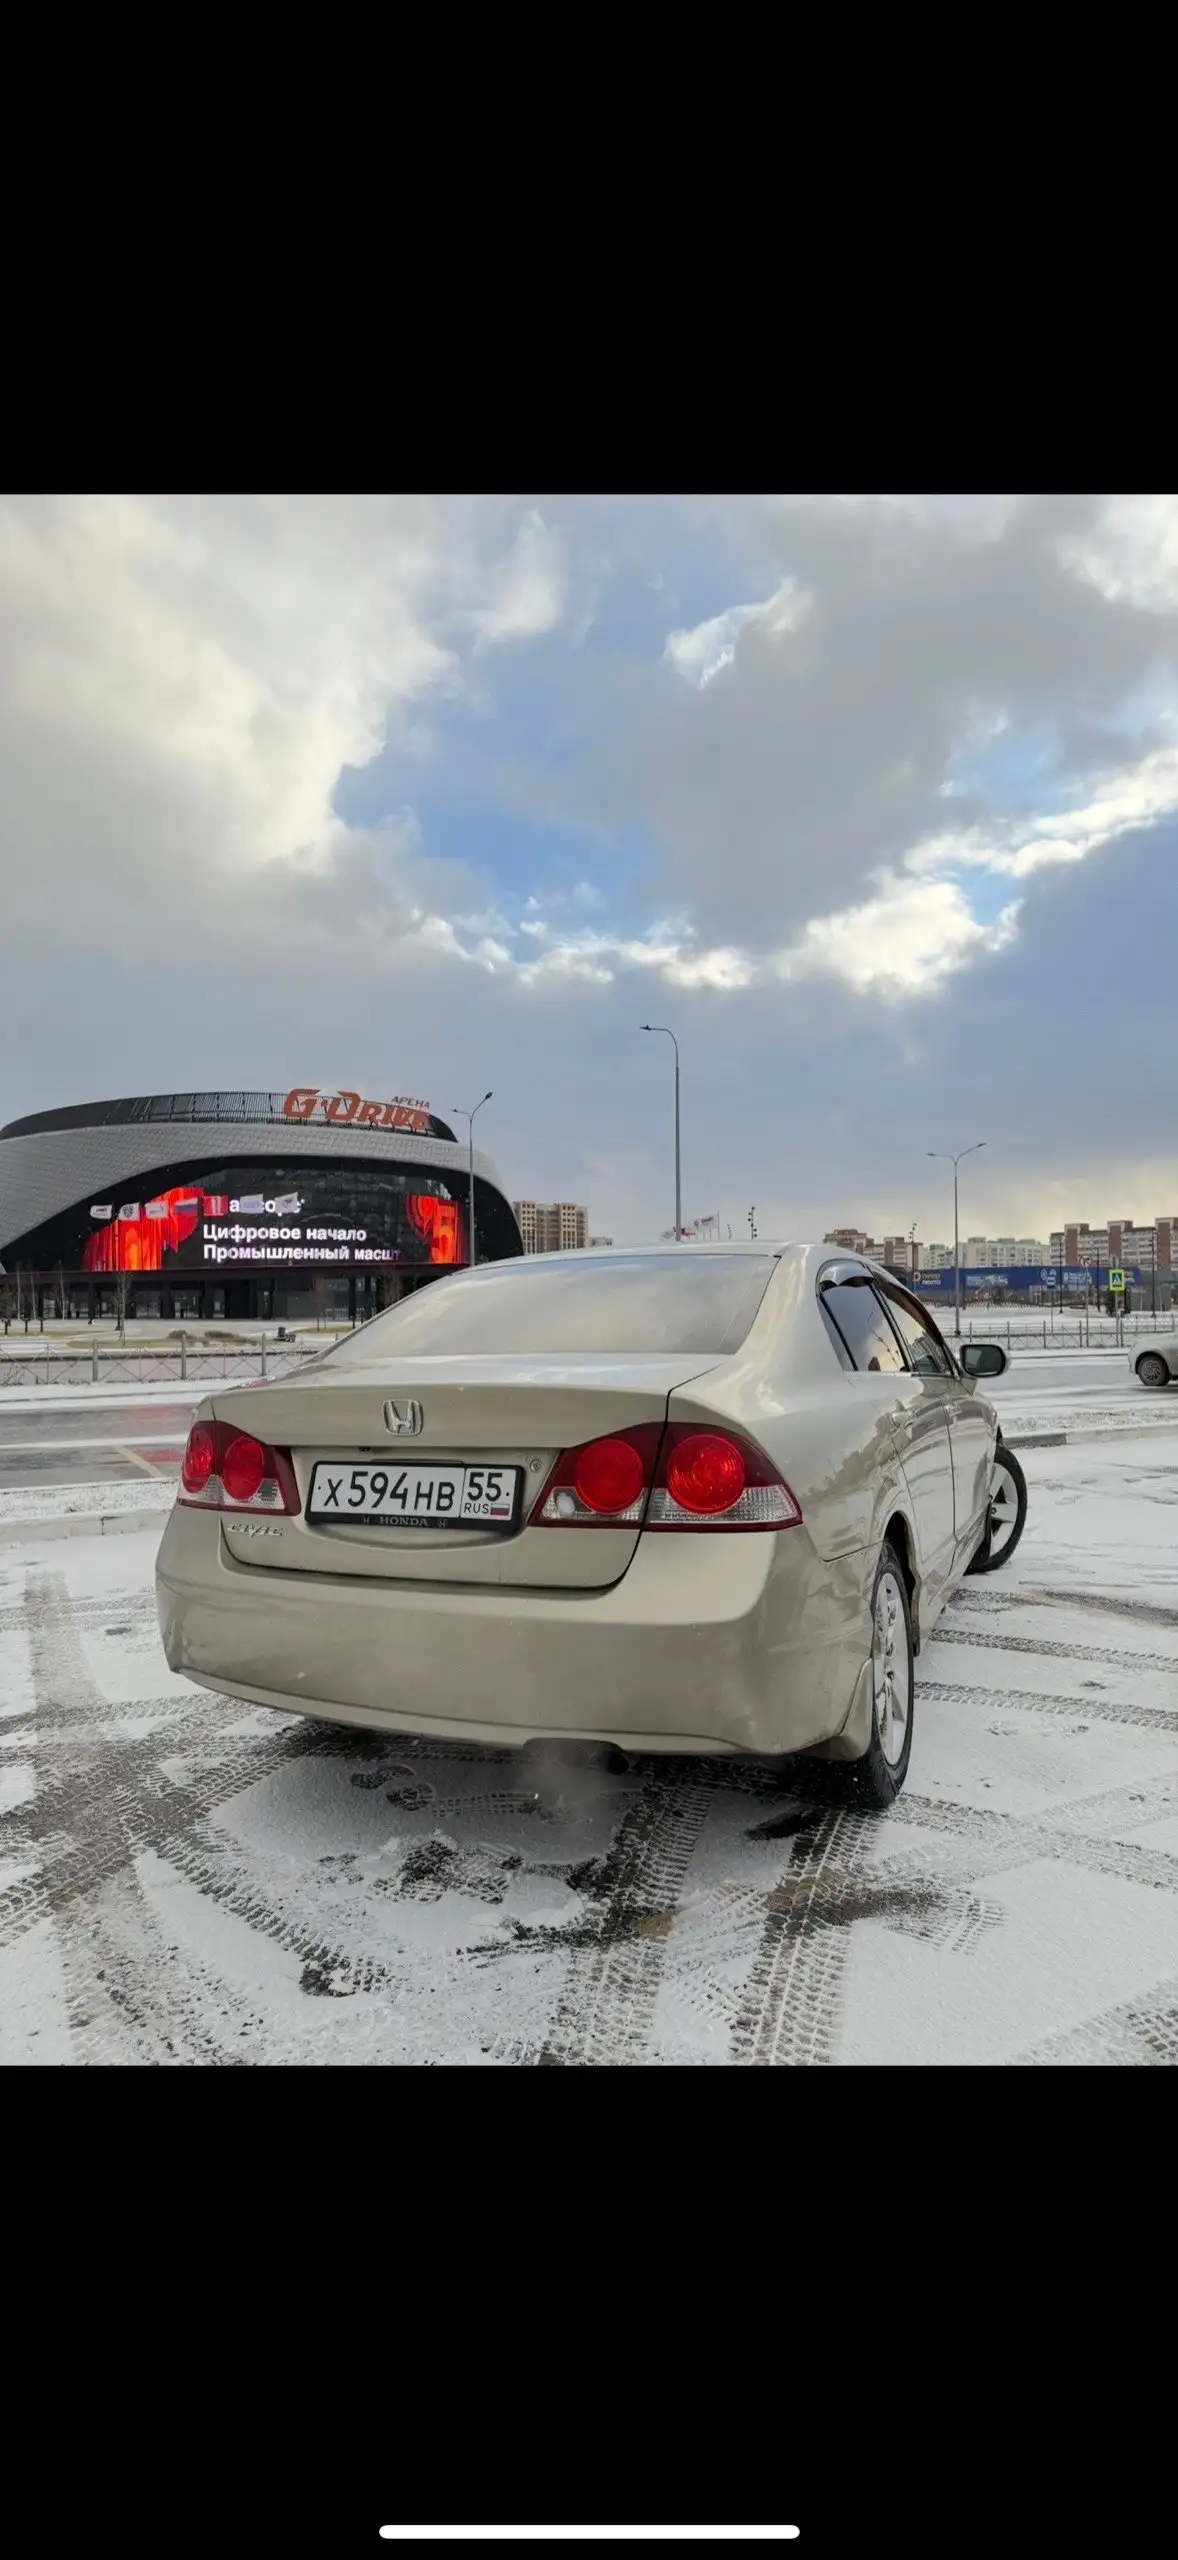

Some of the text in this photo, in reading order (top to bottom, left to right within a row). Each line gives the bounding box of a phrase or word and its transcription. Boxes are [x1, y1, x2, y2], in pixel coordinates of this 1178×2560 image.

[391, 1095, 430, 1109] АРЕНА
[203, 1224, 367, 1242] Цифровое начало
[203, 1244, 349, 1262] Промышленный
[323, 1471, 503, 1511] Х594НВ 55
[464, 1503, 489, 1514] RUS
[379, 1516, 429, 1527] HONDA
